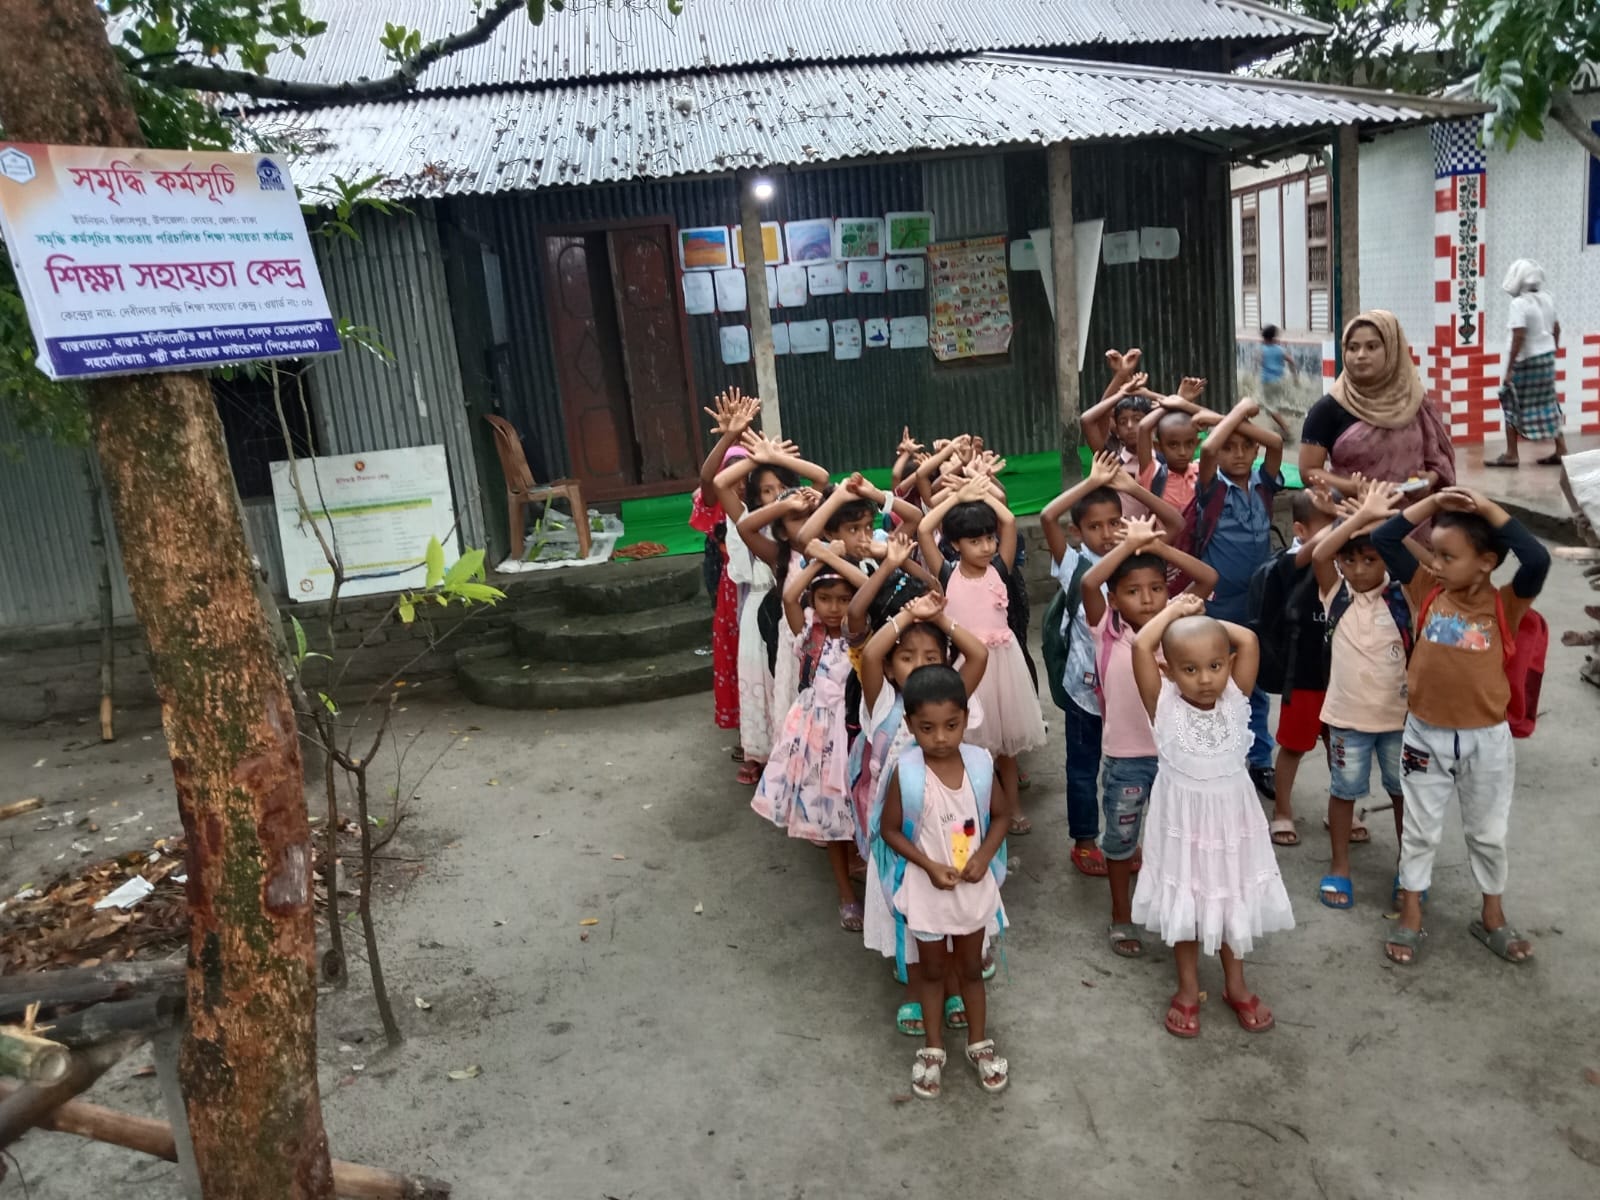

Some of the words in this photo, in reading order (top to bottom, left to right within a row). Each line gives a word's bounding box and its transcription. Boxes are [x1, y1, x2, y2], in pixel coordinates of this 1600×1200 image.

[67, 160, 147, 206] সমৃদ্ধি
[150, 162, 235, 205] কর্মসূচি
[34, 231, 67, 249] সমৃদ্ধি
[156, 230, 200, 244] পরিচালিত
[202, 230, 225, 243] শিক্ষা
[229, 232, 261, 243] সহায়তা
[45, 254, 125, 294] শিক্ষা
[129, 260, 238, 291] সহায়তা
[247, 258, 306, 289] কেন্দ্র
